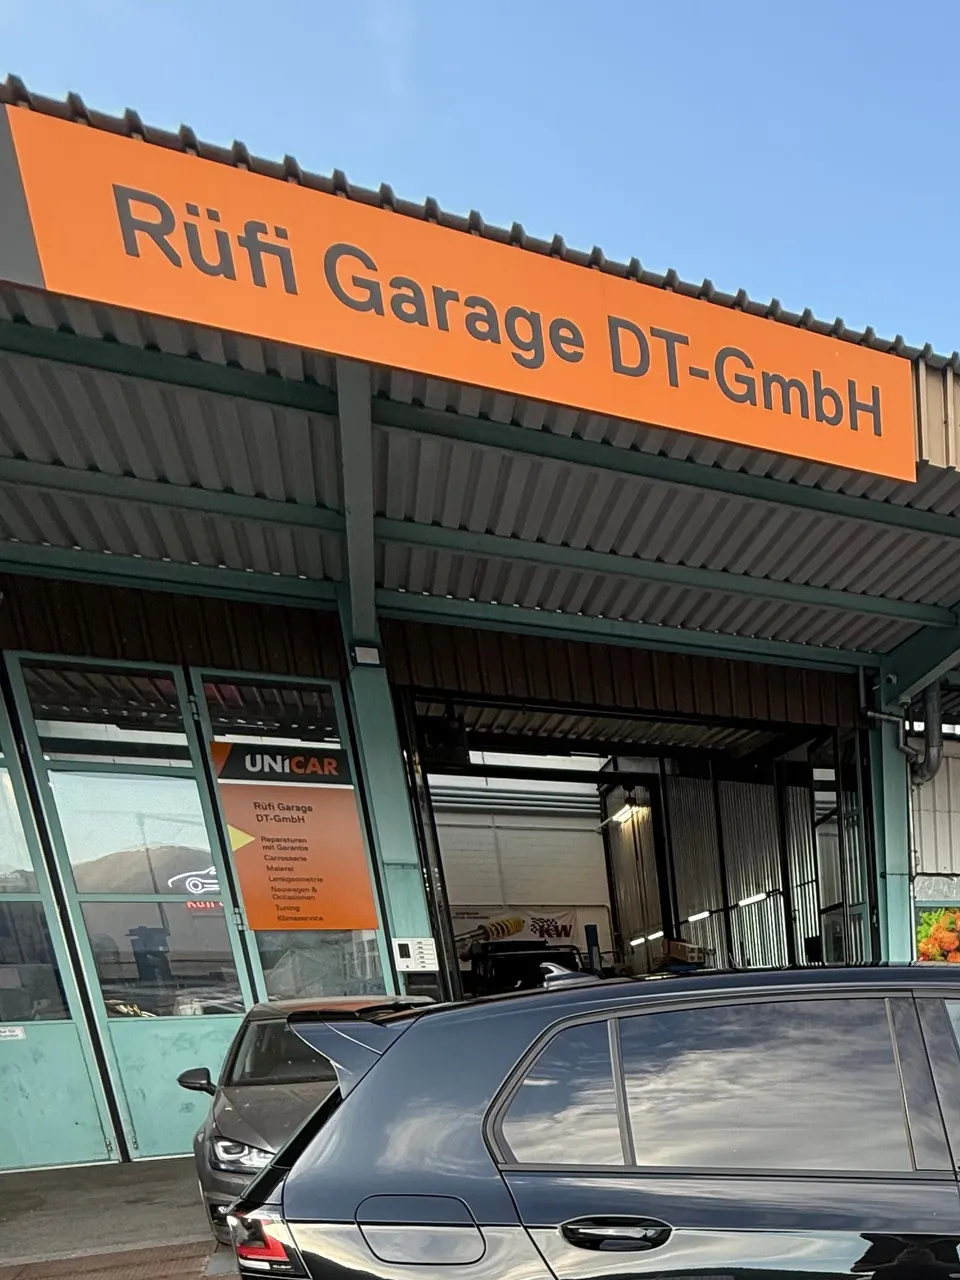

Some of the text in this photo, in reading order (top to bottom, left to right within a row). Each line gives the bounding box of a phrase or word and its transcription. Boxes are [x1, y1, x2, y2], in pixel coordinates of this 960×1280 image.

[111, 183, 883, 437] Rüfi Garage DT-GmbH
[253, 802, 313, 813] Rüfi Garage
[256, 814, 306, 823] DT-GmbH
